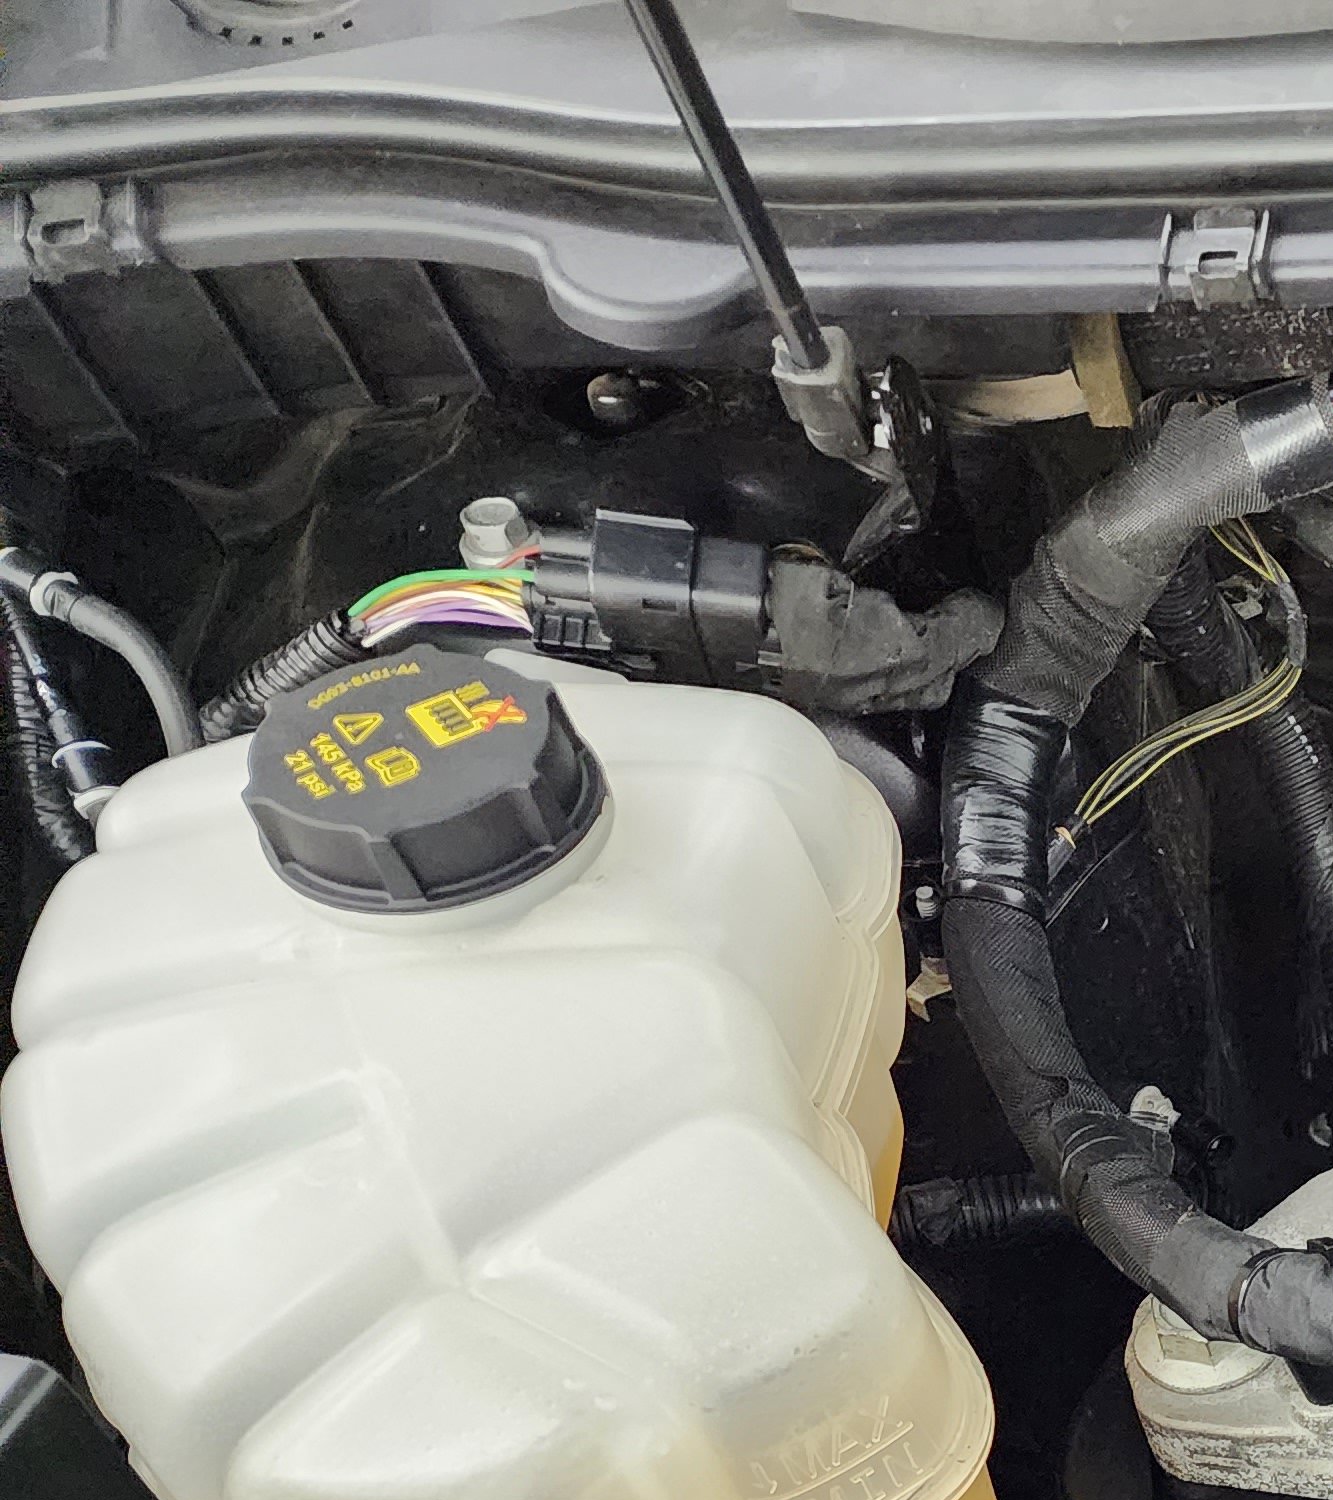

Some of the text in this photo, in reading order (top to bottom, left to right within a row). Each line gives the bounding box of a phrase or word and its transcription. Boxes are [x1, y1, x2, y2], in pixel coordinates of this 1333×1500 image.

[284, 749, 336, 799] 21 psi
[780, 1396, 903, 1485] MAX
